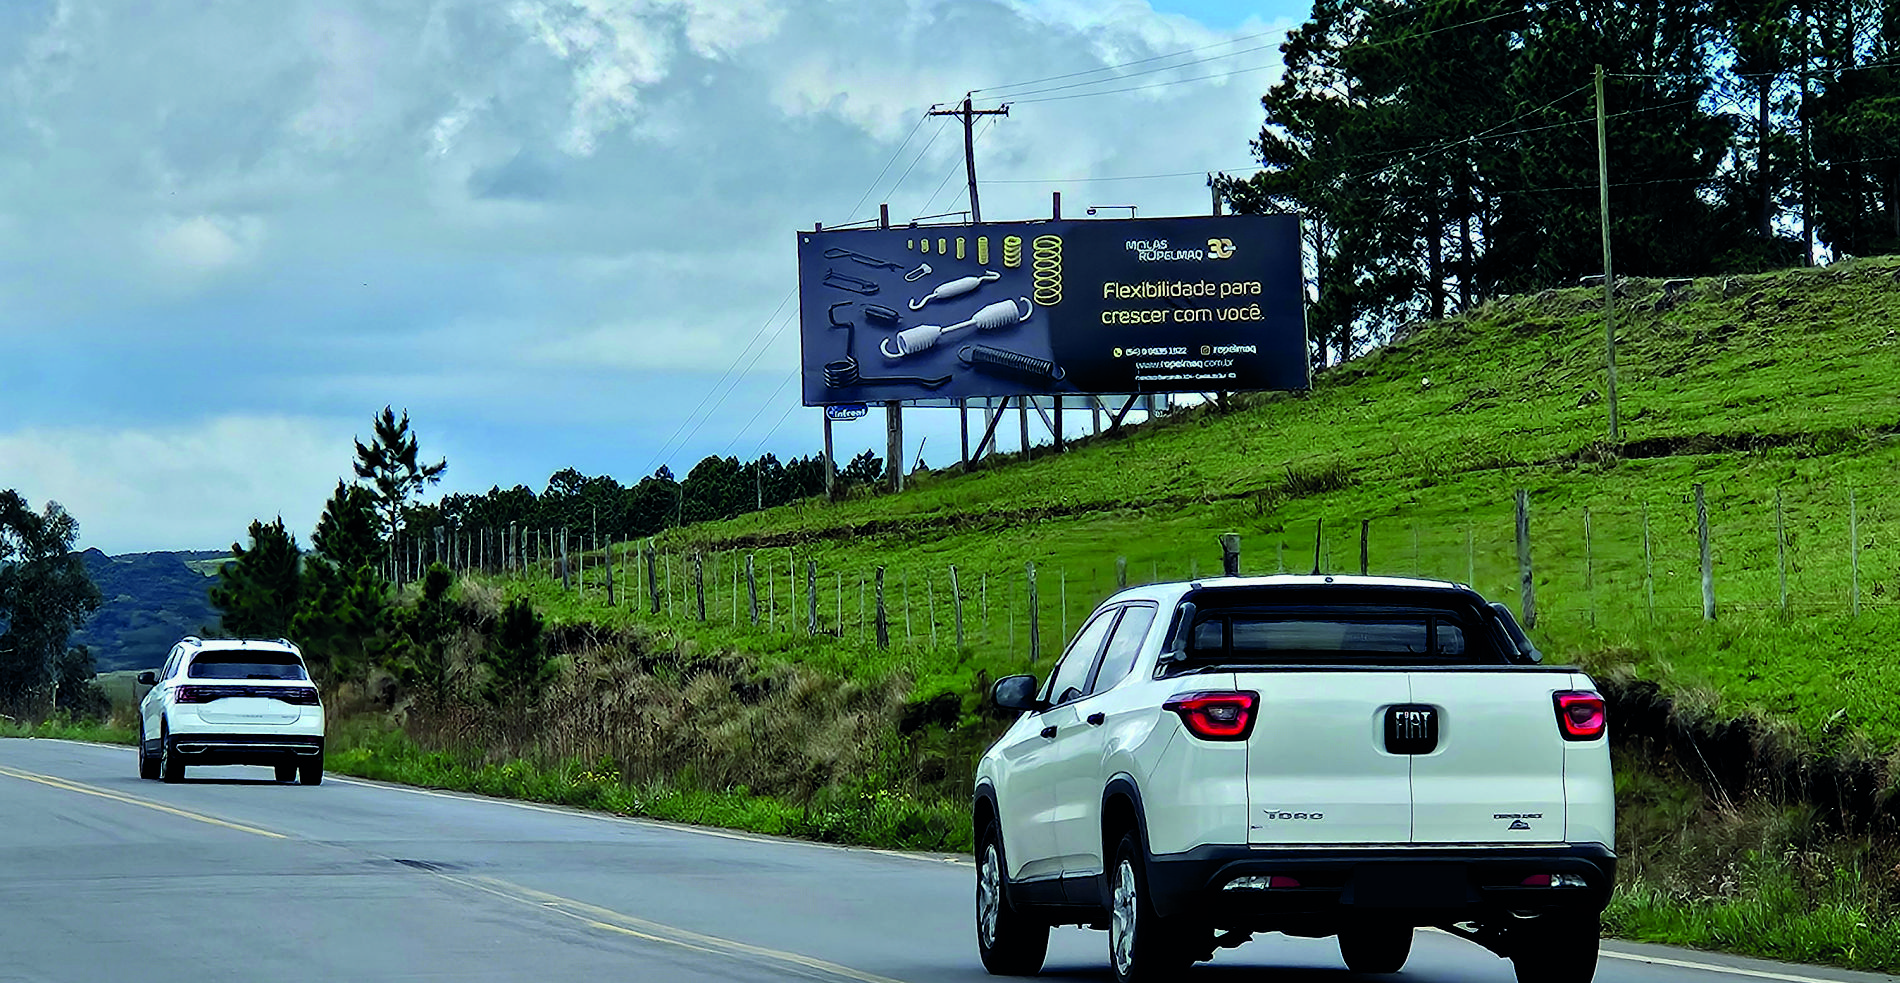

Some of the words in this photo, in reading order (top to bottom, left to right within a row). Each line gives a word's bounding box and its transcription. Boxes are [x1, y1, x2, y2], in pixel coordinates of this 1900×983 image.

[1125, 239, 1168, 251] MOLAS
[1138, 250, 1204, 261] ROPELMAQ
[1103, 280, 1216, 299] Flexibilidade
[1220, 281, 1262, 298] para
[1101, 309, 1169, 324] crescer
[1173, 308, 1213, 322] com
[1216, 303, 1265, 321] você.
[1395, 711, 1431, 739] FIAT
